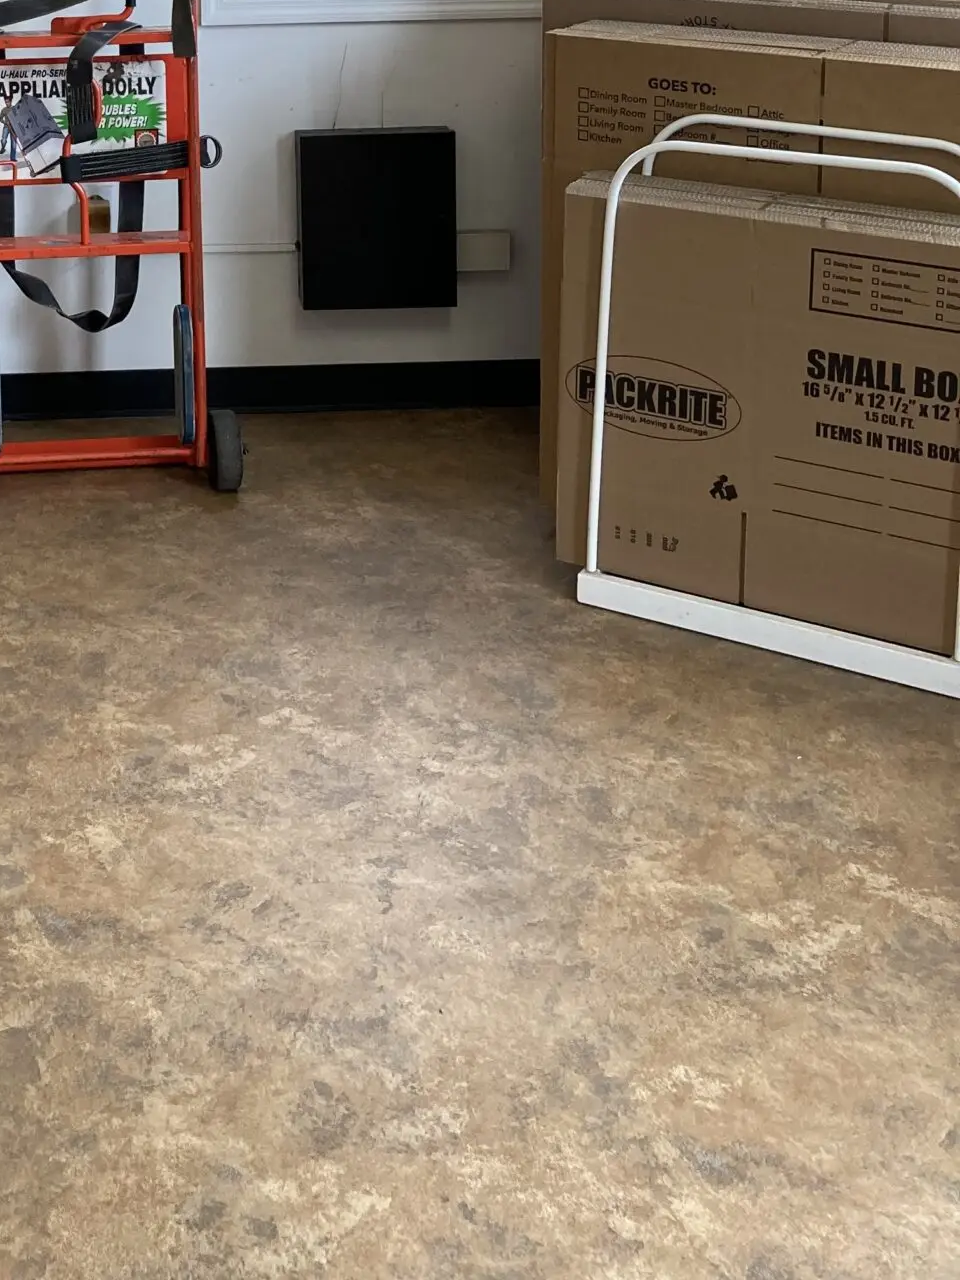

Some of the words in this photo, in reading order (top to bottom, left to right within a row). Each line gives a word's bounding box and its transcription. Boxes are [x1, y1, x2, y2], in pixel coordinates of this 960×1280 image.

[0, 69, 29, 79] U-HAUL
[102, 76, 156, 95] DOLLY
[648, 77, 688, 93] GOES
[690, 81, 717, 95] TO:
[590, 90, 619, 103] Dining
[621, 93, 648, 105] Room
[590, 104, 618, 117] Family
[620, 107, 646, 119] Room
[666, 98, 698, 110] Master
[700, 101, 743, 114] Bedroom
[108, 115, 148, 128] POWER!
[760, 109, 785, 120] Attic
[590, 119, 615, 131] Living
[617, 121, 644, 133] Room
[590, 133, 622, 144] Kitchen
[807, 348, 906, 394] SMALL
[914, 366, 960, 404] BO
[802, 381, 820, 397] 16
[867, 392, 885, 410] 12
[932, 403, 951, 421] 12
[639, 417, 667, 429] Moving
[677, 423, 708, 436] Storage
[864, 410, 879, 423] 1.5
[881, 413, 899, 427] CU.
[900, 417, 915, 429] FT.
[816, 421, 863, 444] ITEMS
[866, 431, 883, 448] IN
[886, 434, 923, 456] THIS
